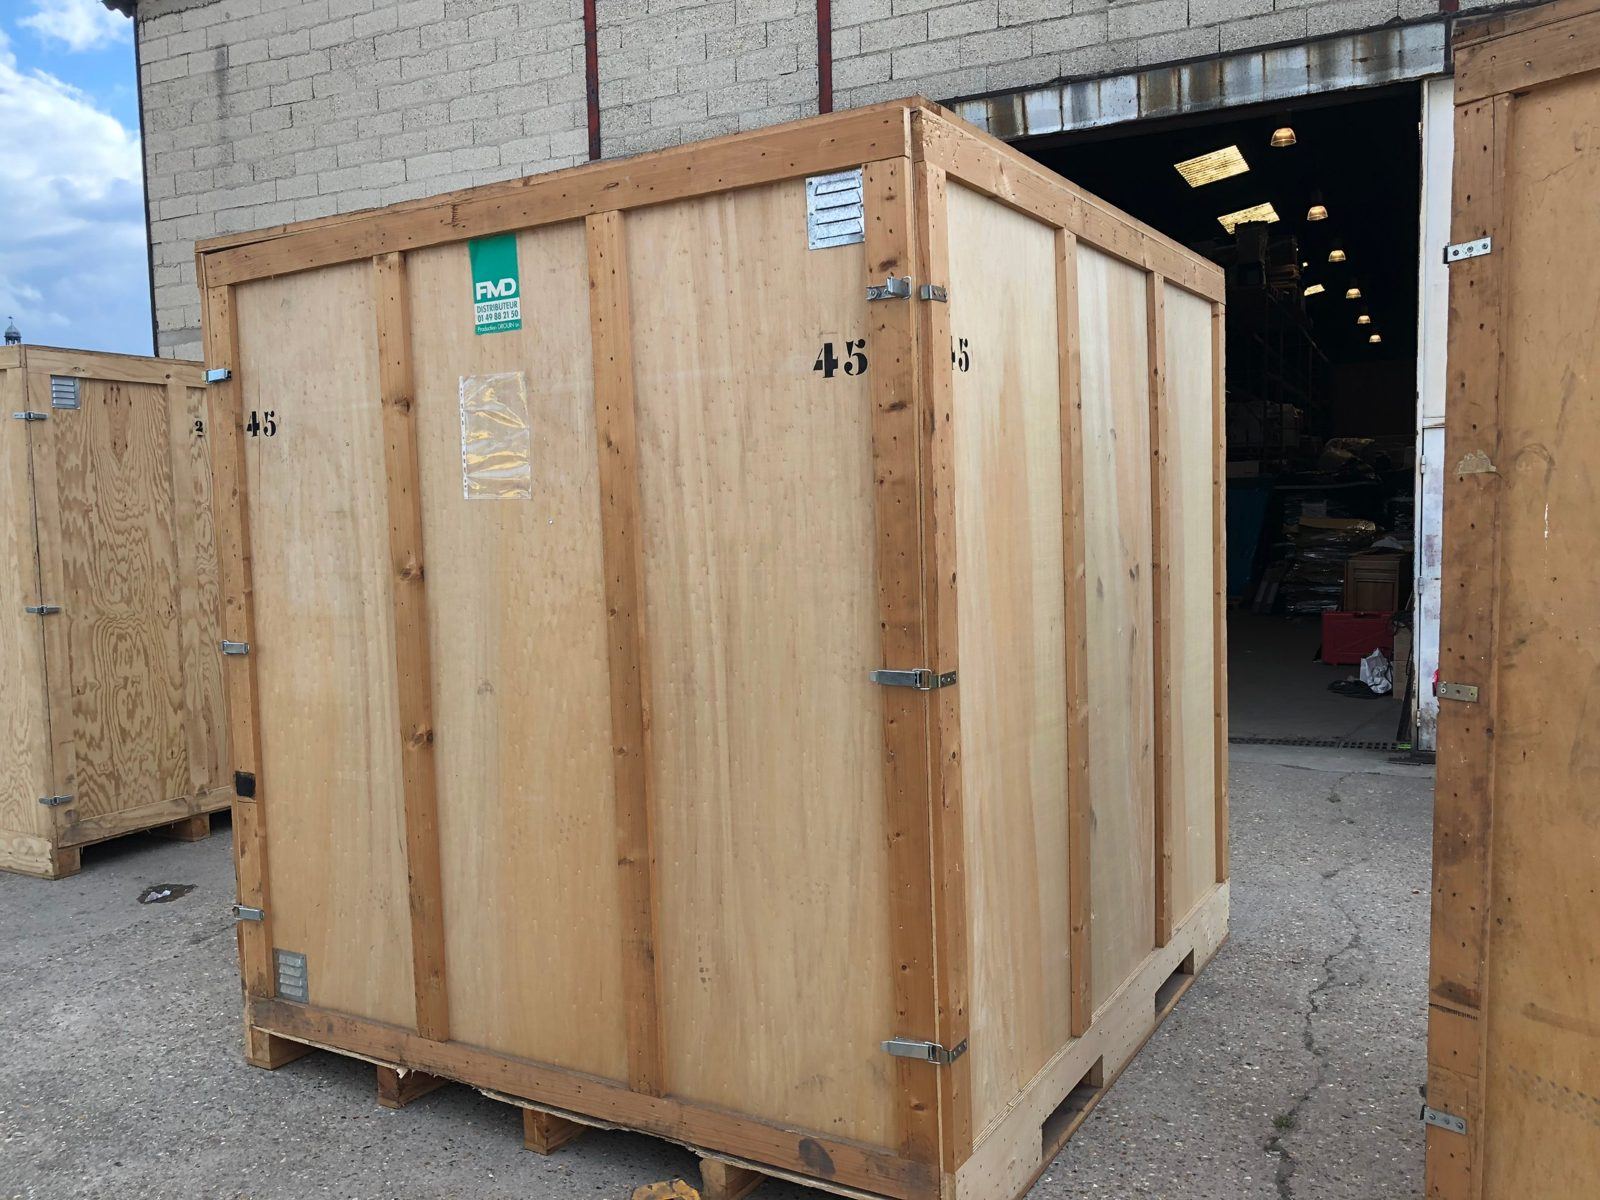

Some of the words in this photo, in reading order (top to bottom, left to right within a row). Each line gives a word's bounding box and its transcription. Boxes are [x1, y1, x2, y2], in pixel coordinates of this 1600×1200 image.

[476, 278, 517, 300] FMD
[477, 301, 518, 313] DISTRIBUTEUR
[485, 313, 493, 321] 49
[494, 312, 502, 320] 88
[503, 311, 510, 319] 21
[511, 310, 519, 318] 50
[813, 339, 868, 378] 45
[246, 410, 277, 437] 45
